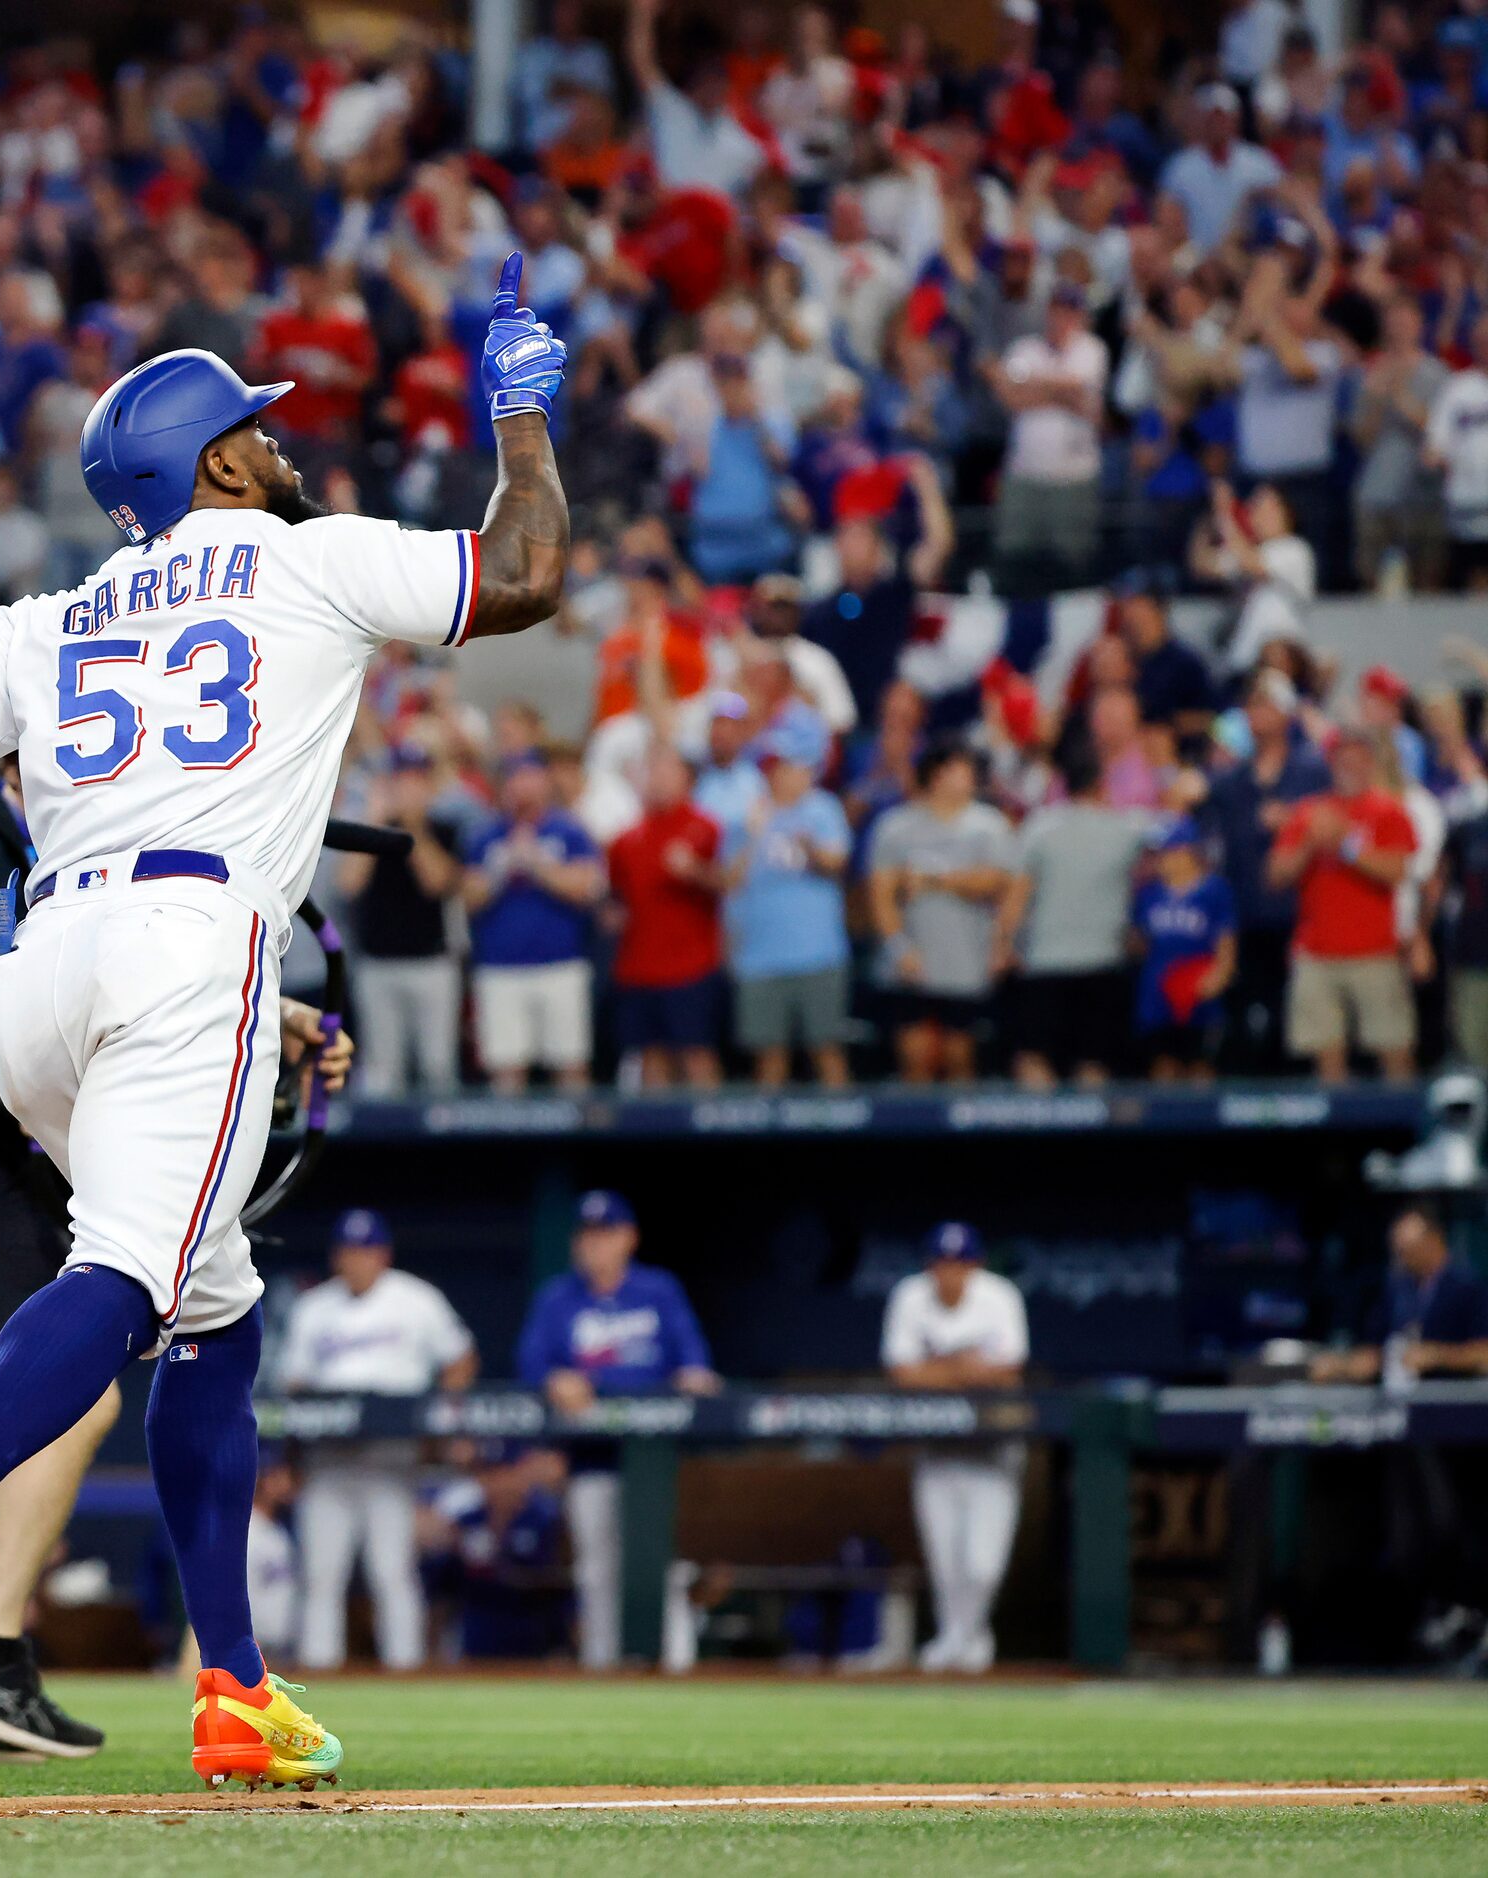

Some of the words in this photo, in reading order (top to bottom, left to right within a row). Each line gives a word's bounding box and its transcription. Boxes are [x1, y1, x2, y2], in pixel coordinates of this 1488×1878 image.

[502, 339, 546, 370] Franklin
[109, 505, 136, 529] 53
[62, 544, 260, 636] GARCIA
[53, 618, 263, 787] 53
